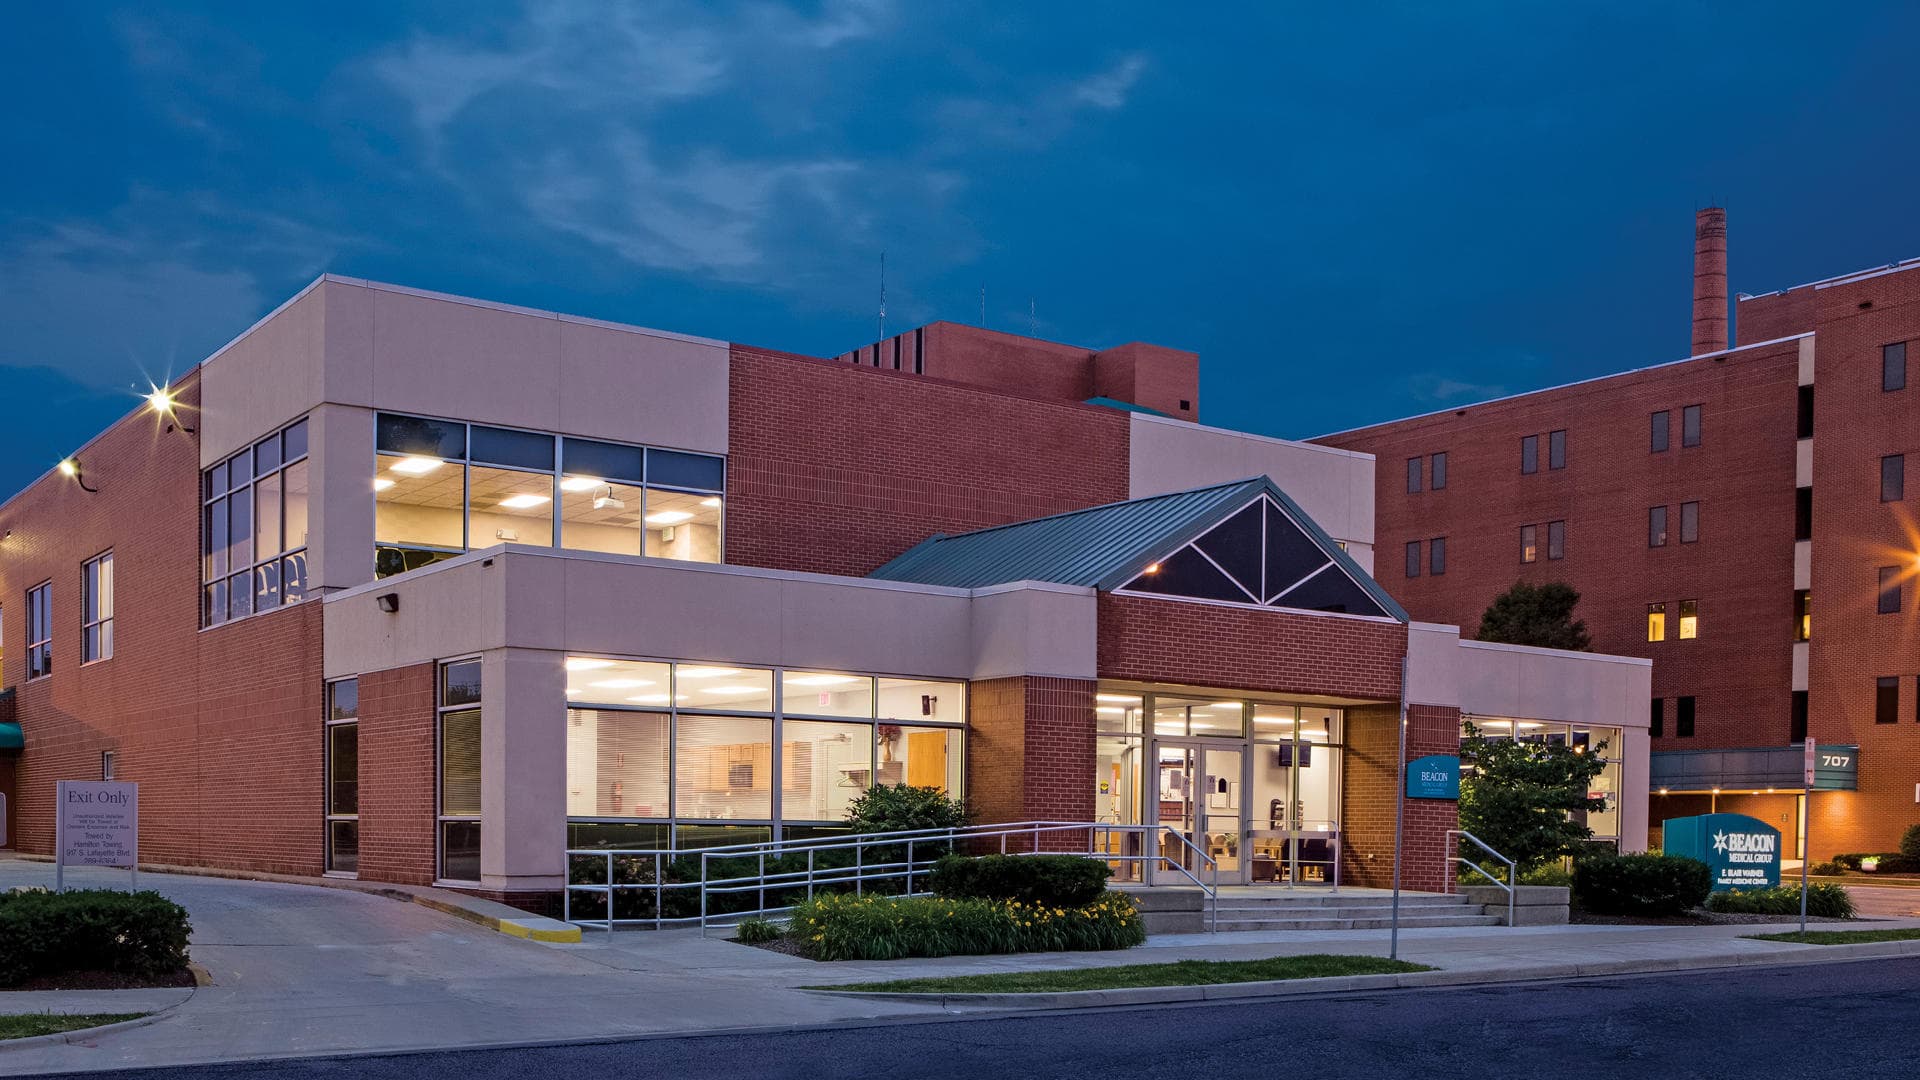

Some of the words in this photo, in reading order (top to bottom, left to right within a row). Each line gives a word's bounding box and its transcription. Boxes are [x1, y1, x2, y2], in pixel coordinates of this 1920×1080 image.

[1822, 755, 1850, 767] 707
[1421, 771, 1448, 782] BEACON
[68, 790, 93, 804] Exit
[98, 790, 129, 807] Only
[1728, 833, 1775, 852] BEACON
[1728, 853, 1754, 863] MEDICAL
[1754, 854, 1773, 864] GROUP
